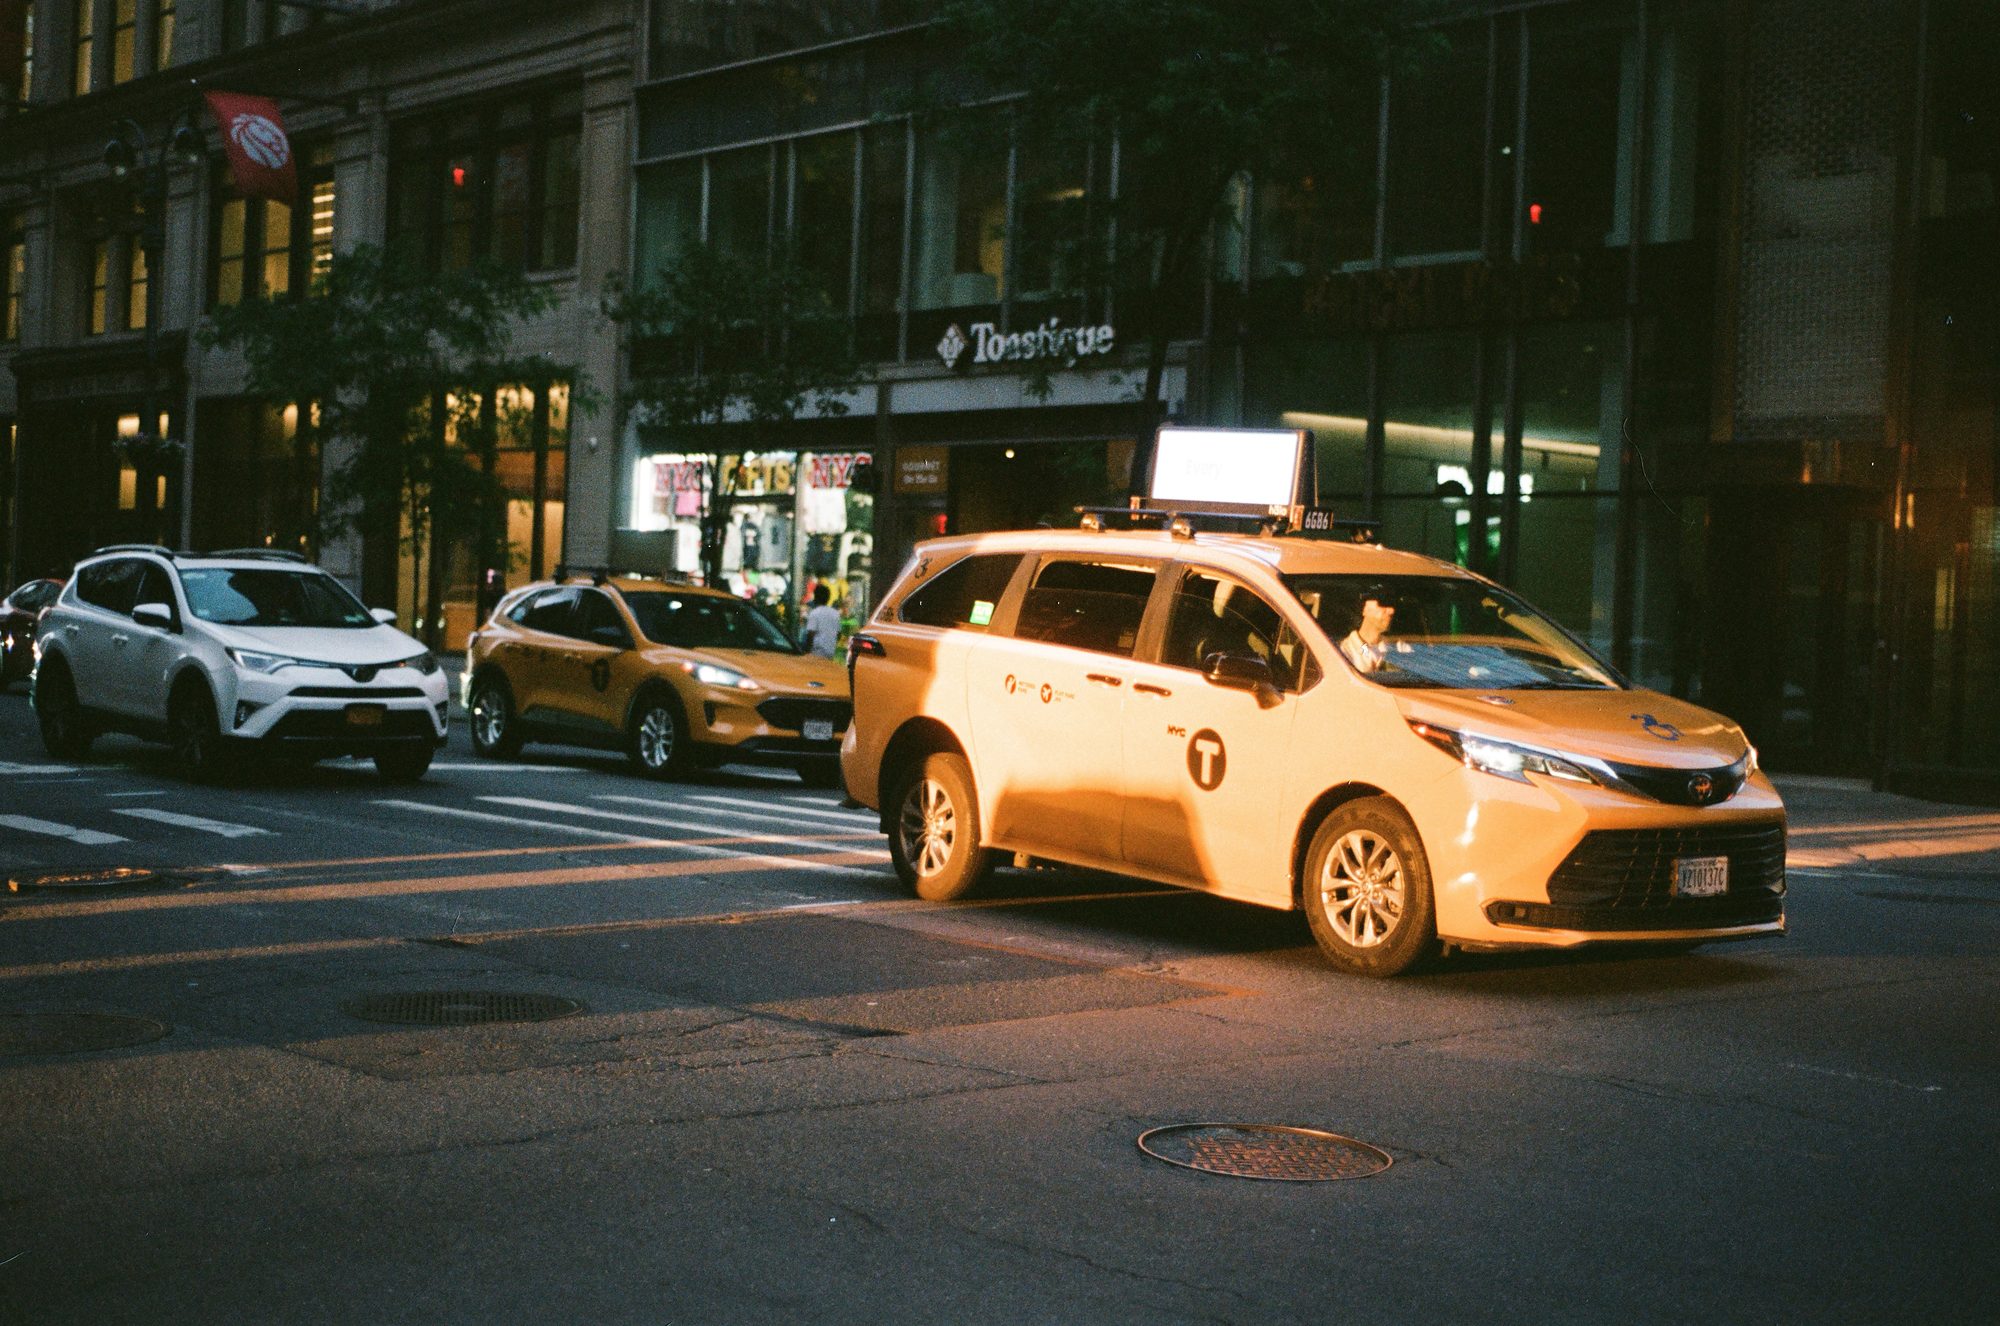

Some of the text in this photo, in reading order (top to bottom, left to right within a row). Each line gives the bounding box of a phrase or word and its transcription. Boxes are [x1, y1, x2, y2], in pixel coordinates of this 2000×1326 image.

[811, 453, 873, 489] NY
[1185, 459, 1224, 481] Every
[1167, 724, 1187, 738] NYC
[1195, 738, 1220, 785] T
